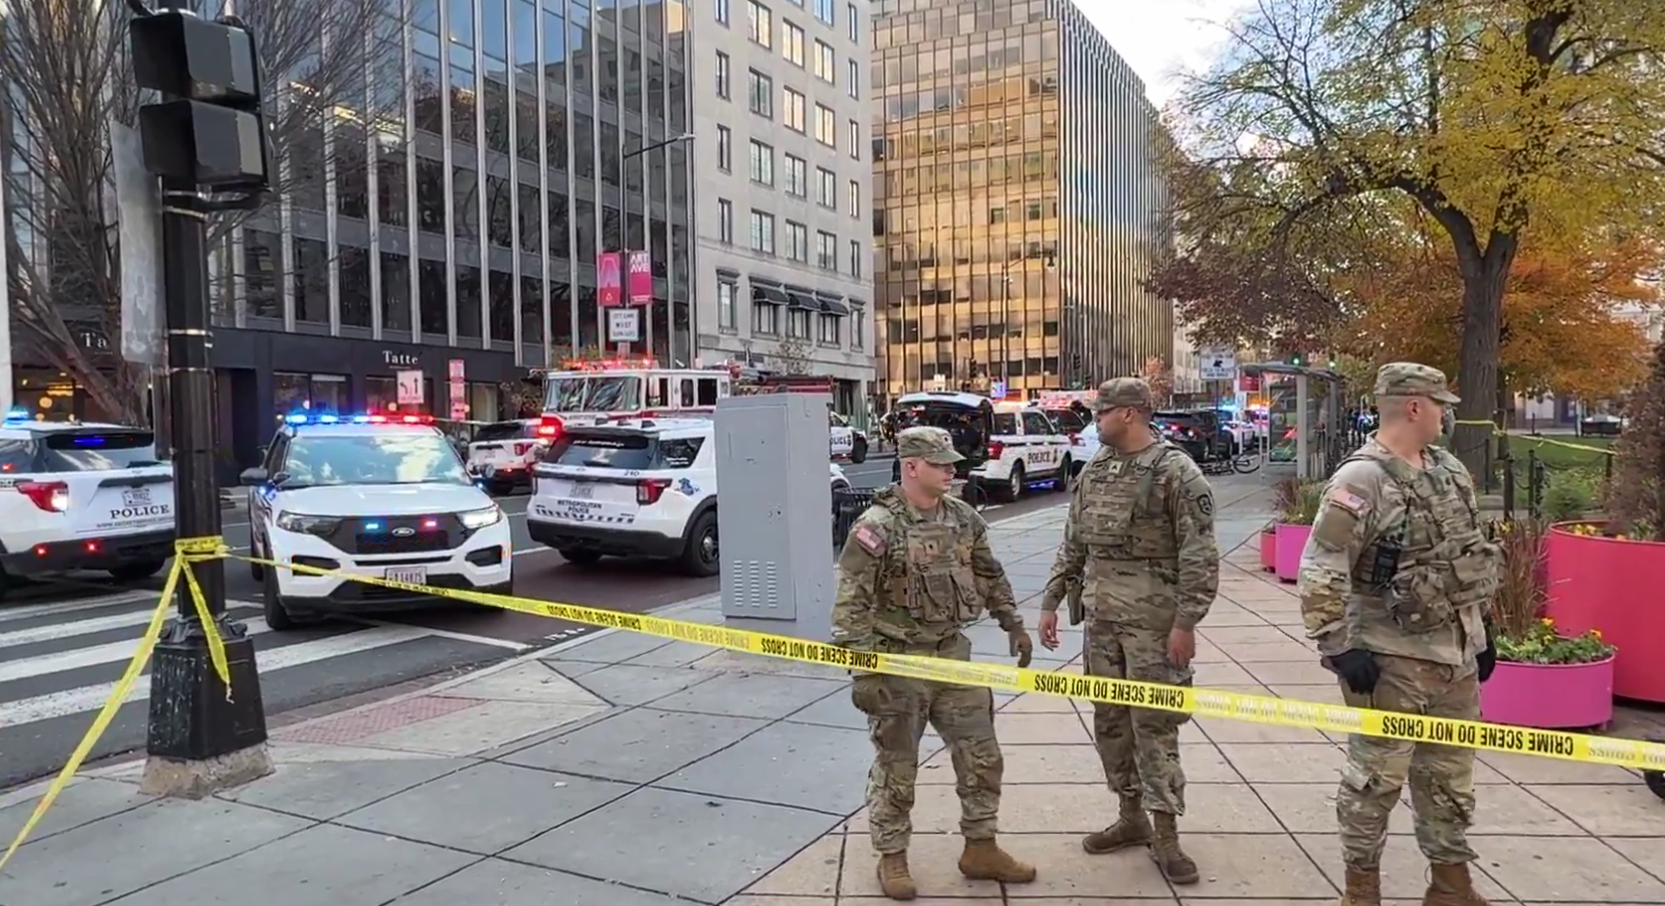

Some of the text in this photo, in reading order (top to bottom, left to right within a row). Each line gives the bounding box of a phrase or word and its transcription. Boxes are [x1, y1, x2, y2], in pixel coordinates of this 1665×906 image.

[630, 253, 649, 263] ART
[630, 263, 650, 273] AVE
[382, 350, 418, 364] Tatte
[1027, 451, 1051, 465] POLICE
[109, 504, 170, 519] POLICE
[557, 499, 602, 509] METROPOLITAN
[568, 506, 589, 514] POLICE
[618, 616, 642, 631] CRIME
[761, 638, 787, 656] CROSS
[788, 641, 805, 659] NOT
[806, 644, 818, 660] DO
[820, 646, 847, 665] SCENE
[849, 651, 878, 670] CRIME
[1034, 674, 1185, 709] CRIME SCENE DO NOT CROSS
[1381, 716, 1574, 756] CRIME SCENE DO NOT CROSS
